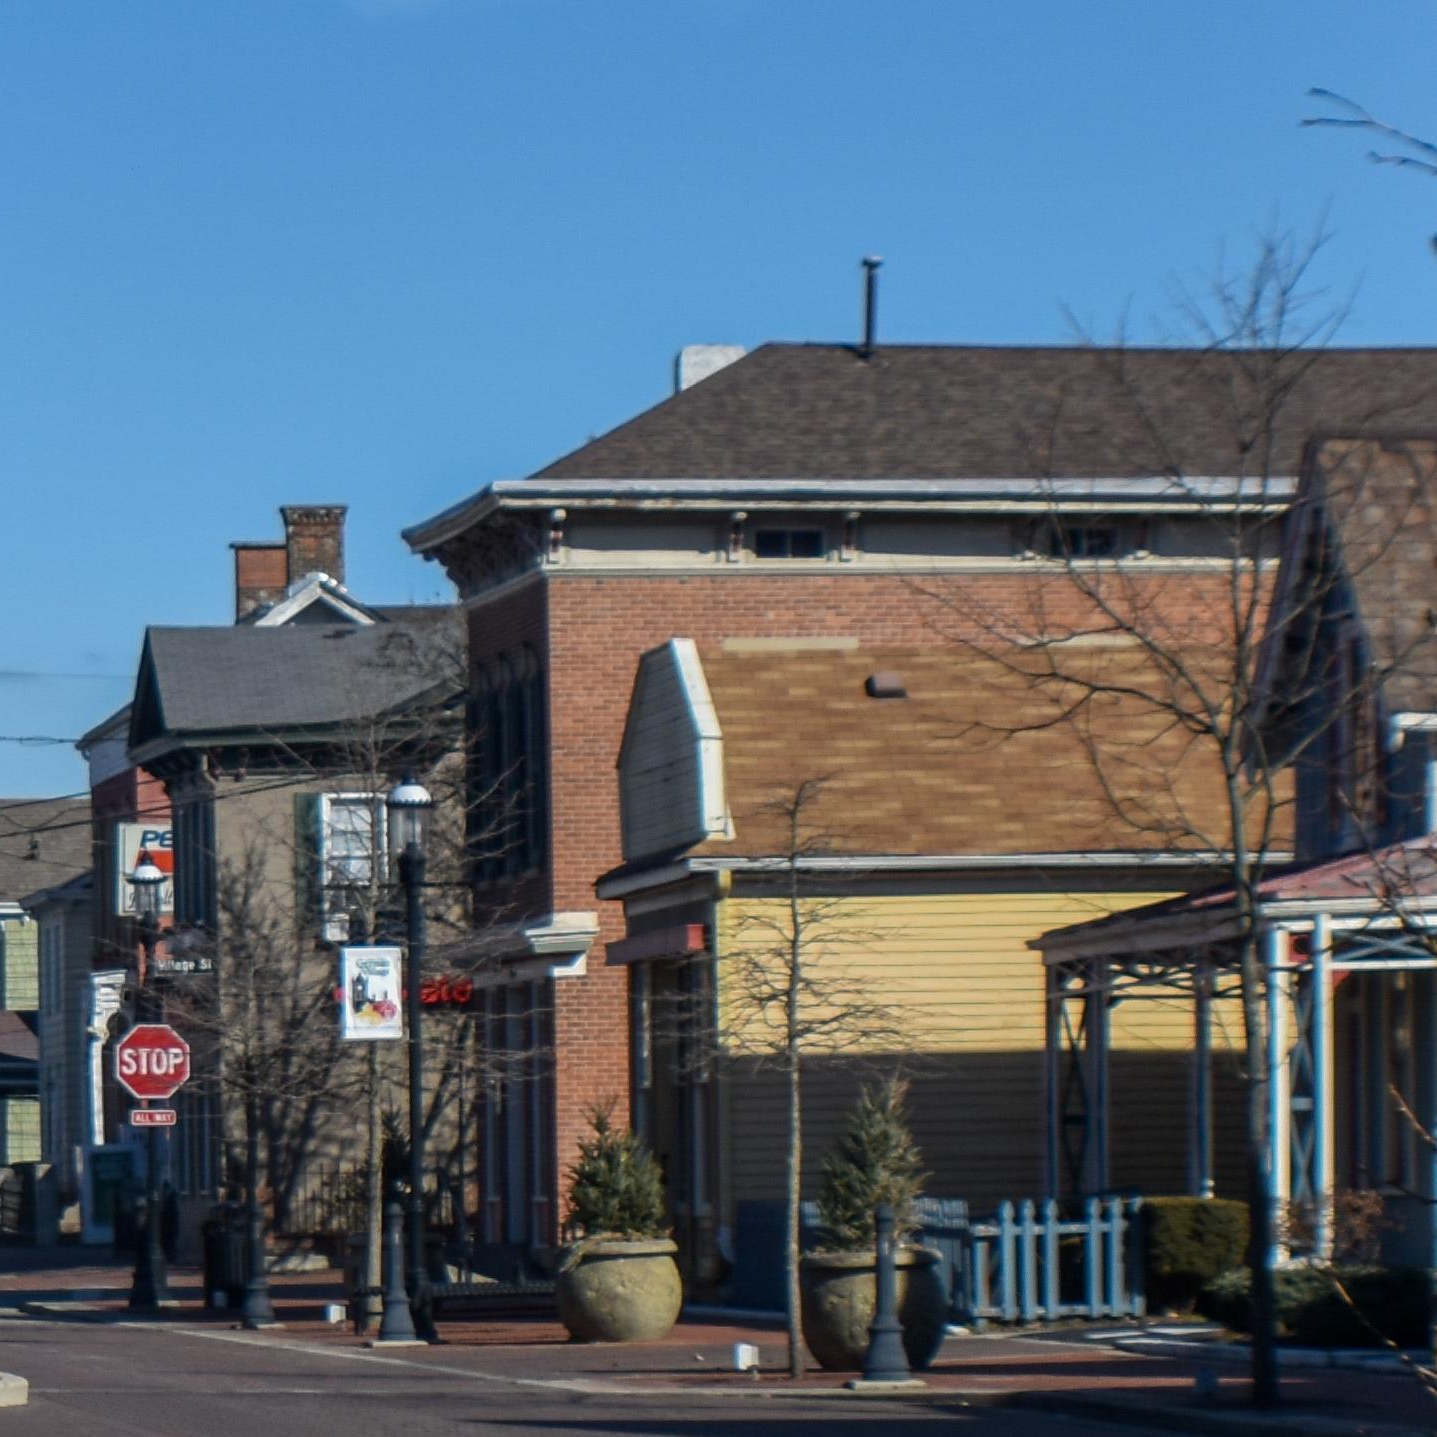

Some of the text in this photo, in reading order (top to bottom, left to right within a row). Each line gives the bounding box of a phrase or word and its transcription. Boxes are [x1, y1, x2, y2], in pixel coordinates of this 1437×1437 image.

[121, 1048, 183, 1075] STOP
[135, 1113, 172, 1123] ALL WAY
